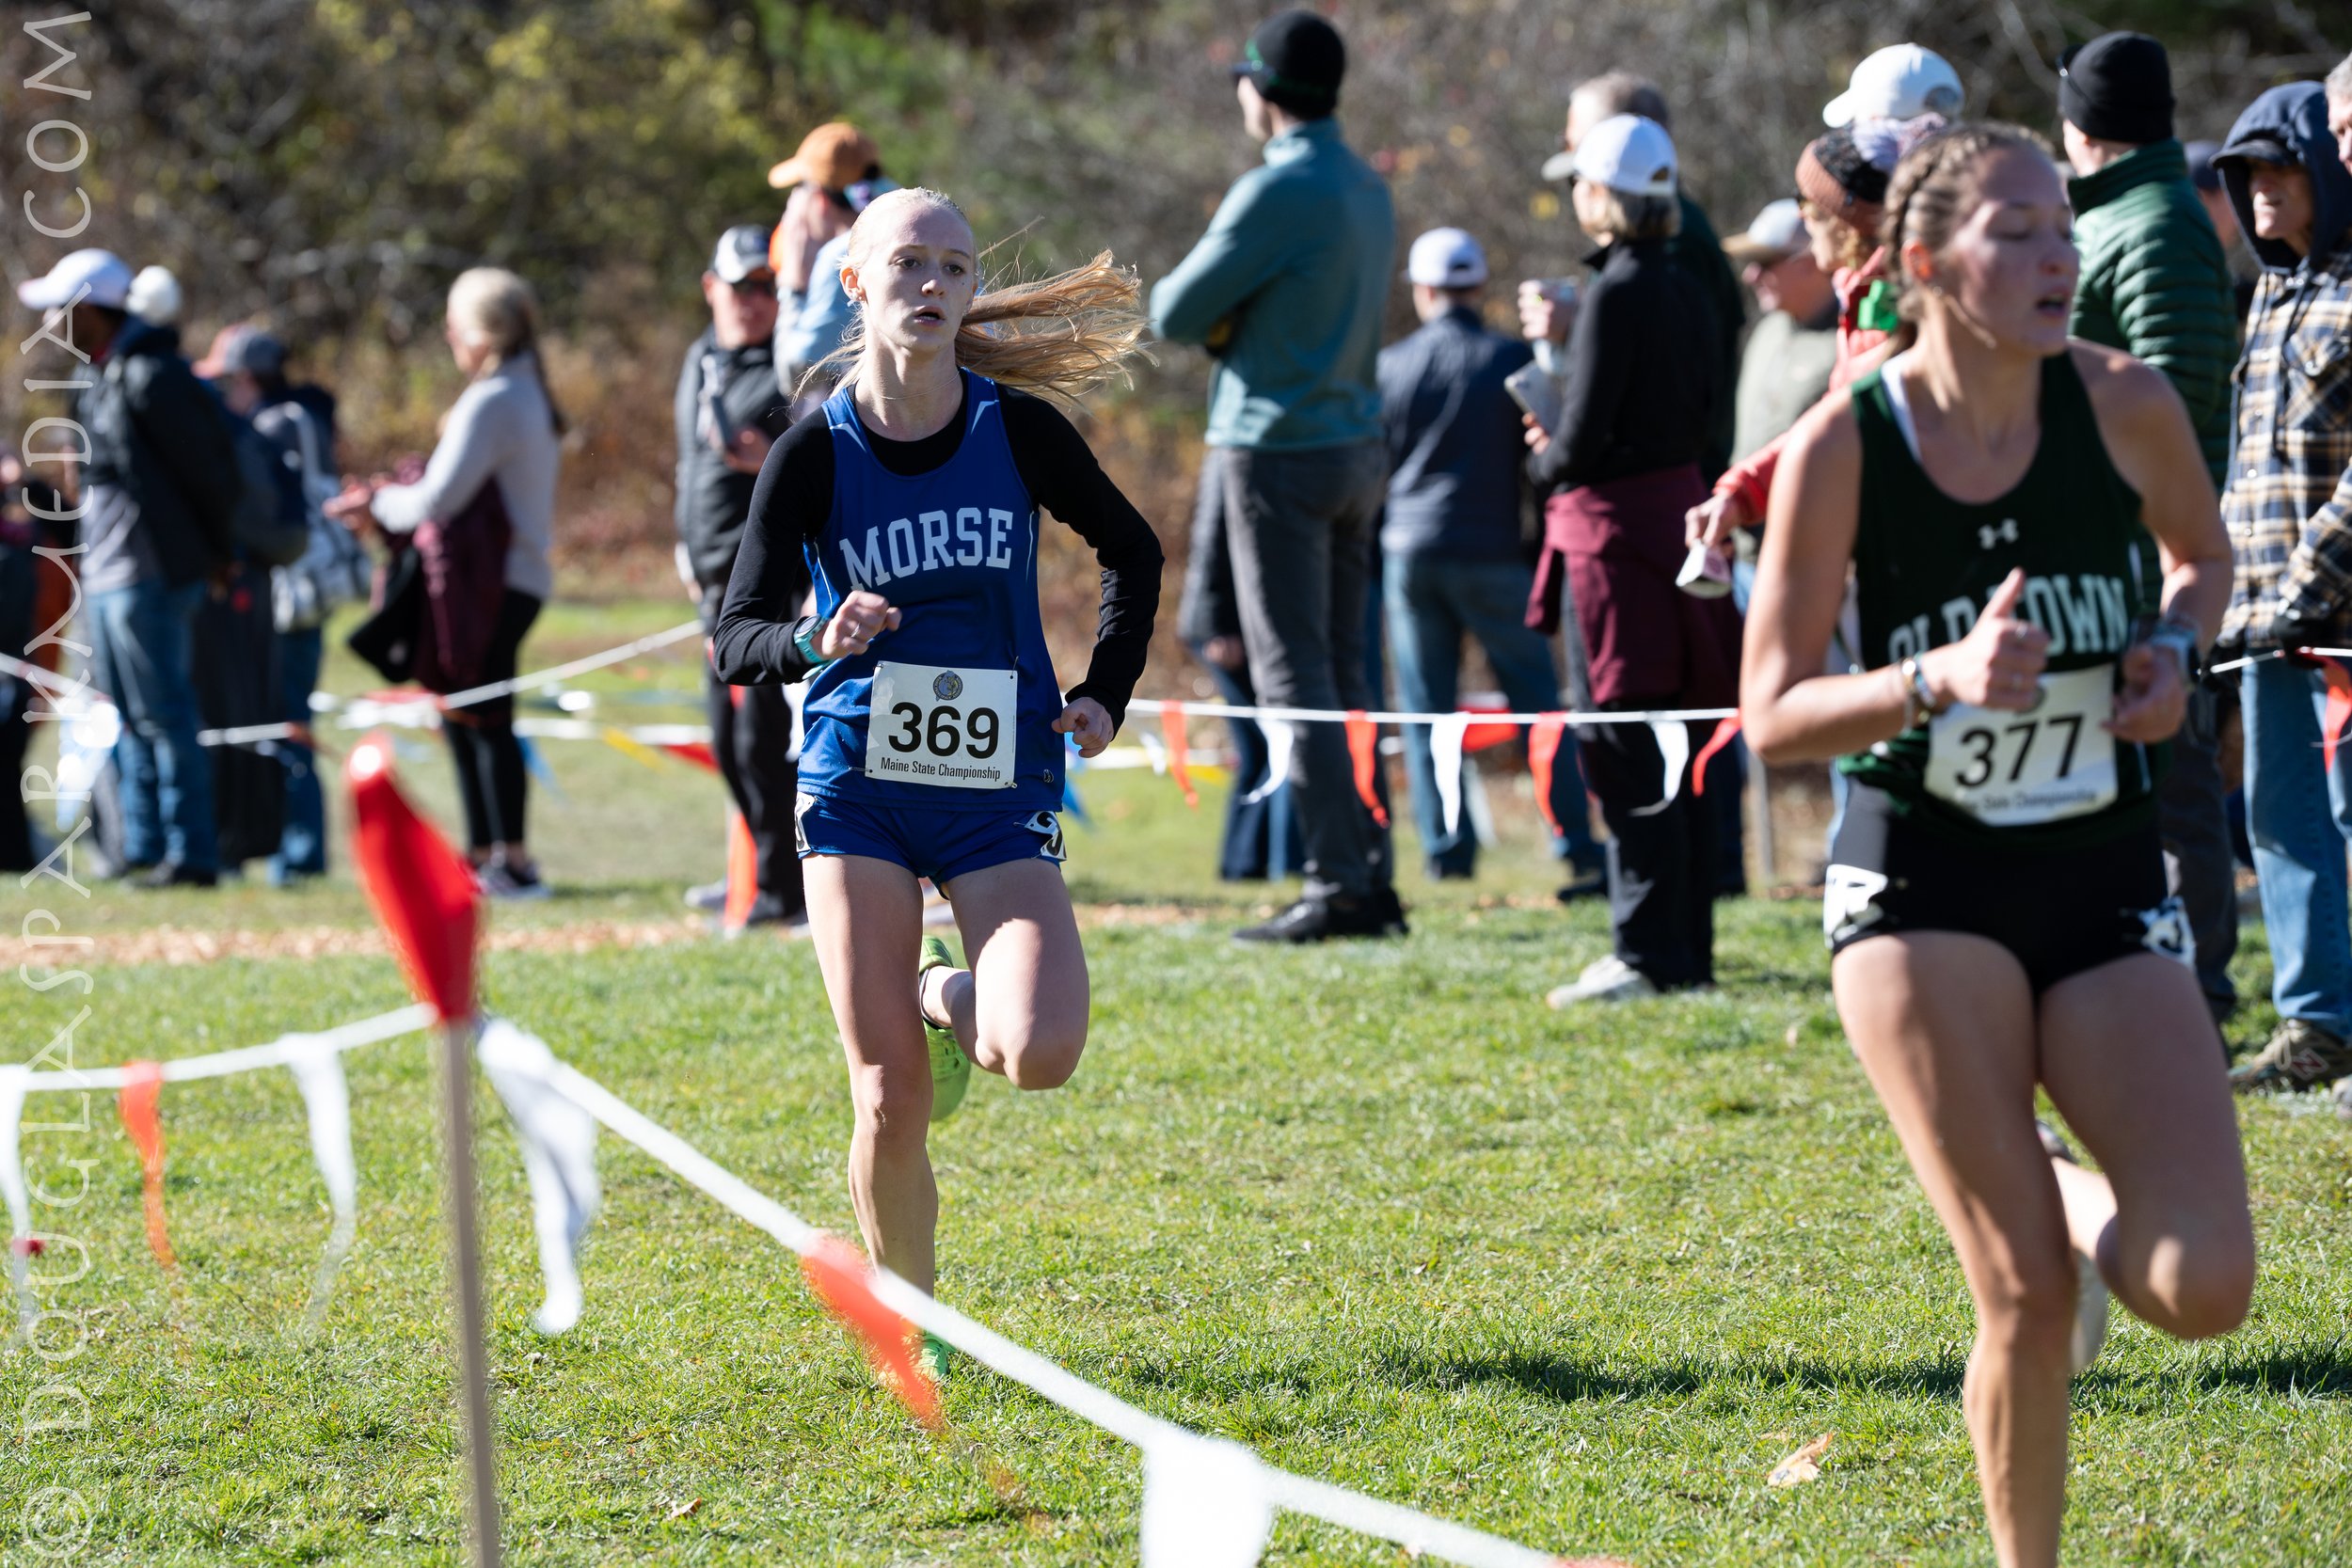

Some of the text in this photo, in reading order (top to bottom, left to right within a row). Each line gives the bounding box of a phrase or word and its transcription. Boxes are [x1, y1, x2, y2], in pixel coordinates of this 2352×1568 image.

[839, 507, 1014, 592] MORSE
[1985, 574, 2129, 656] OWN
[888, 702, 1000, 760] 369
[1954, 714, 2086, 788] 377
[881, 757, 1001, 782] Maine State Championship
